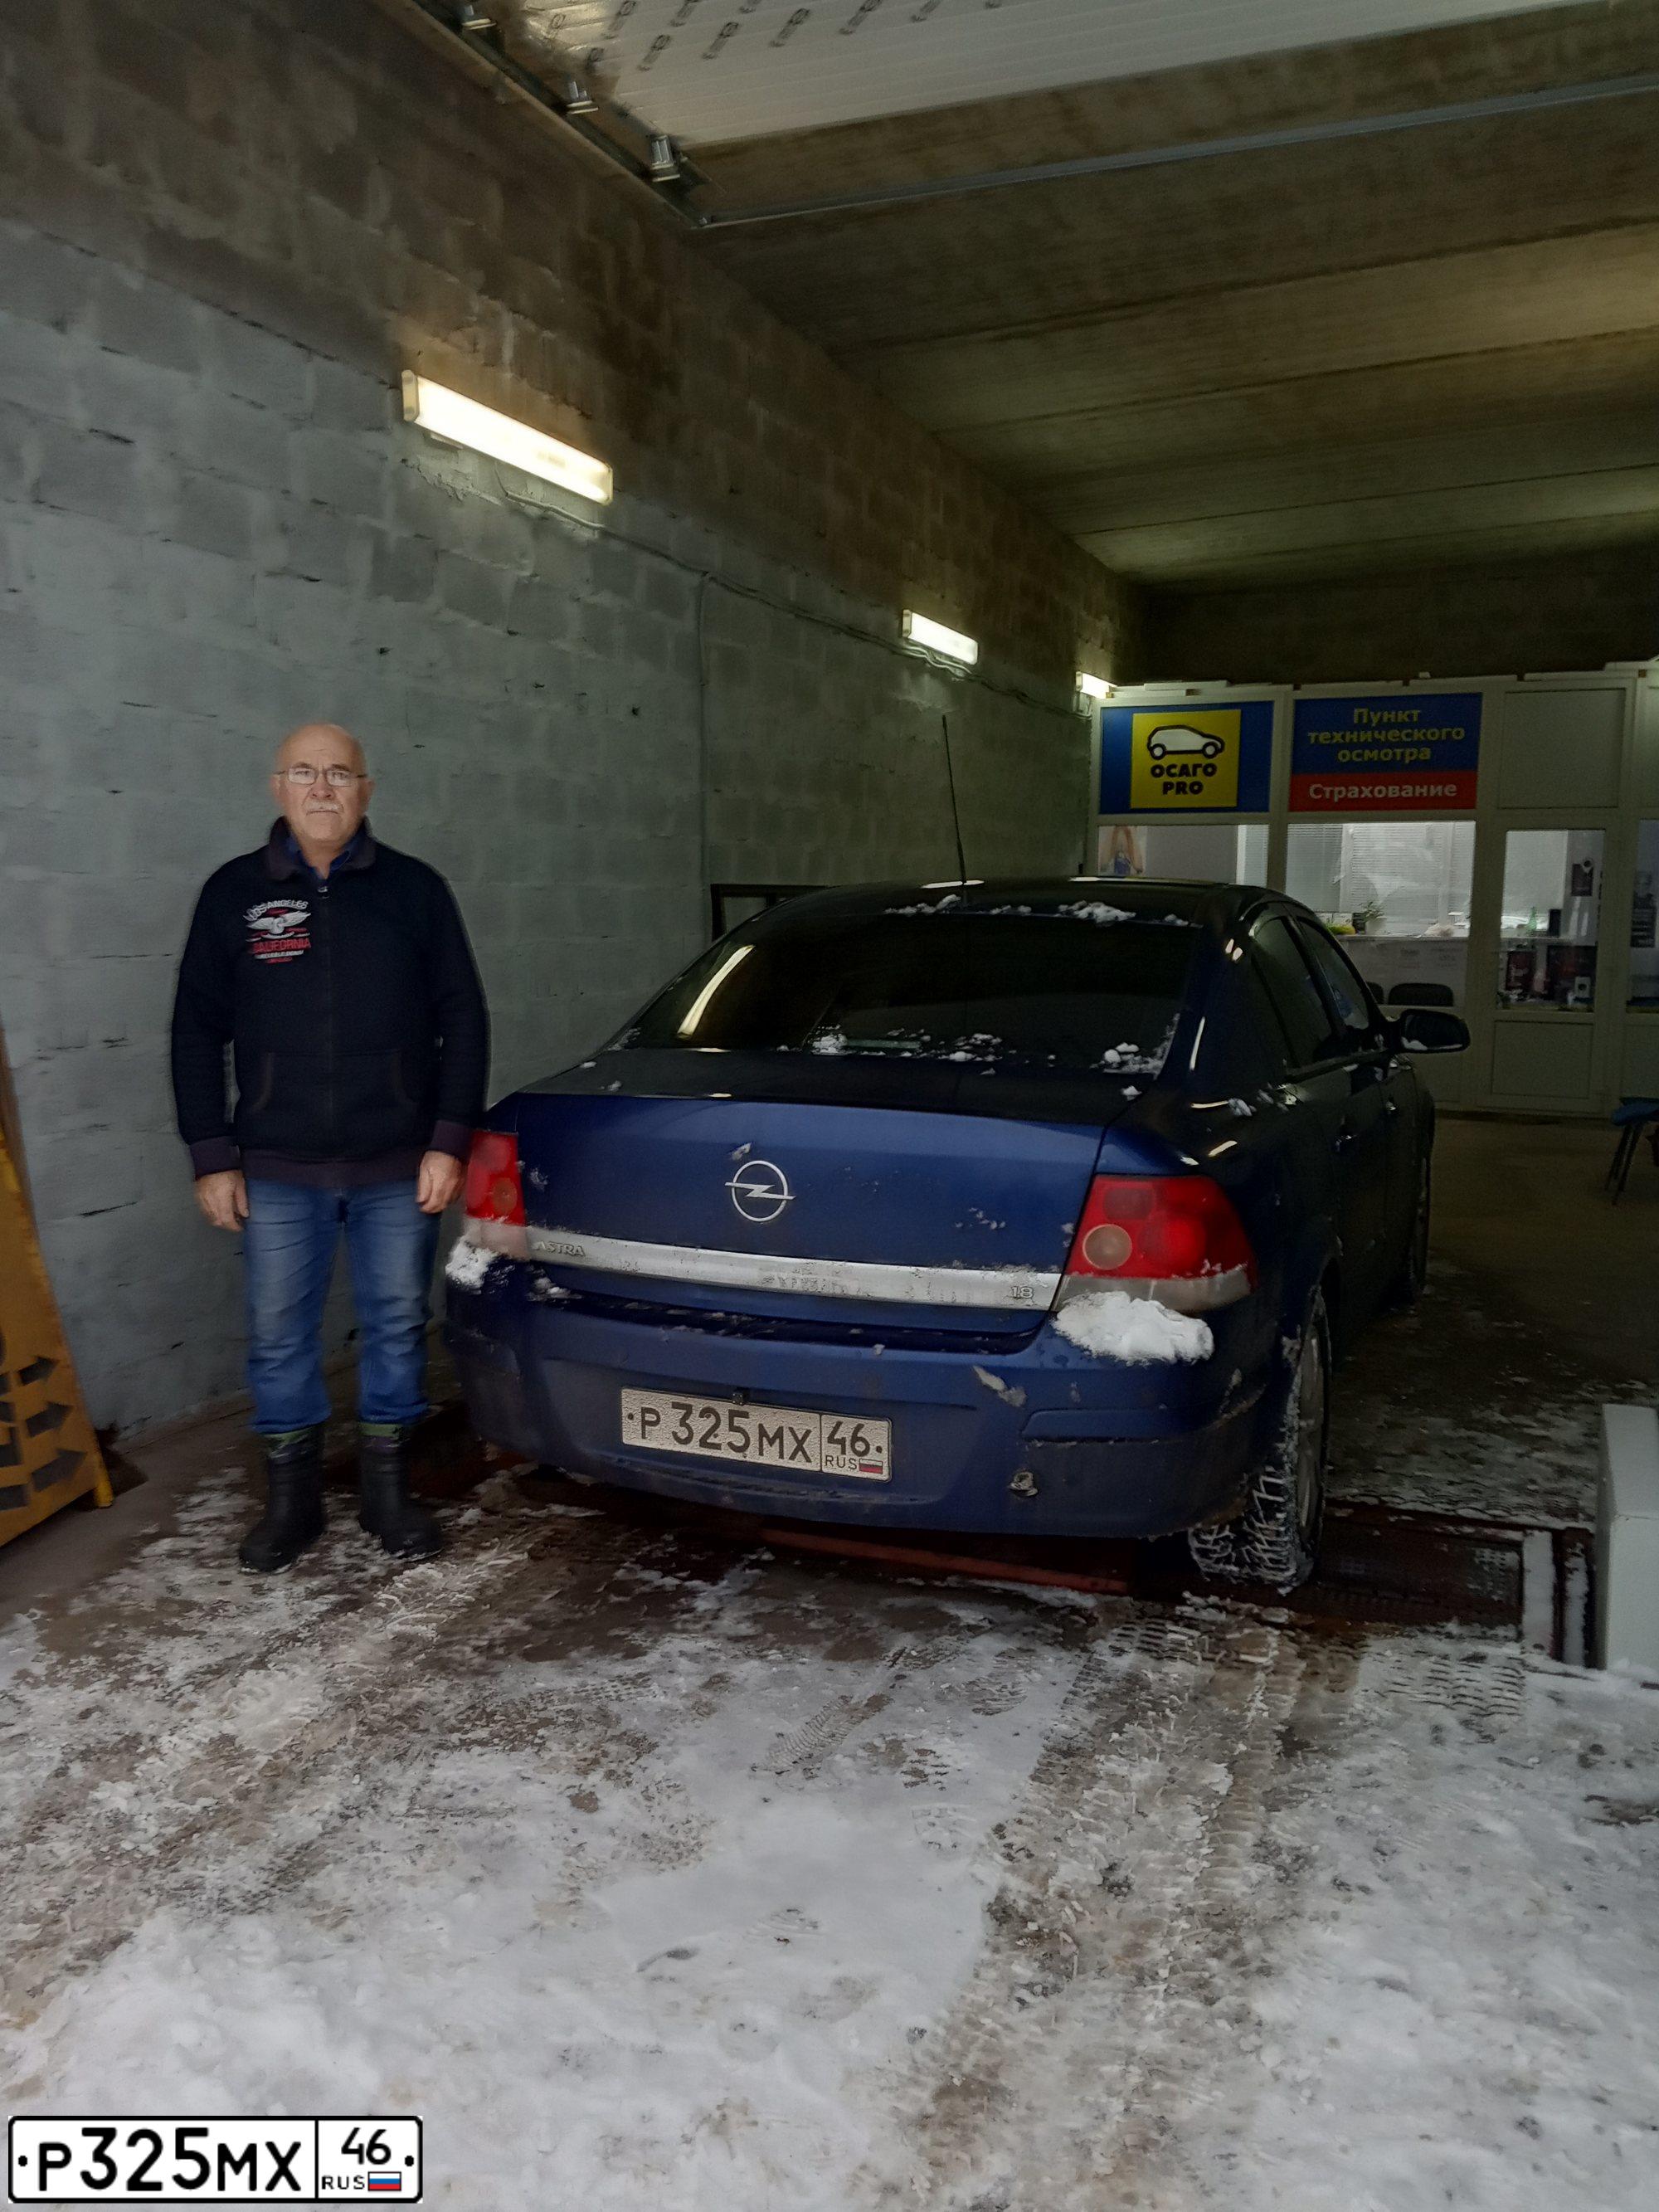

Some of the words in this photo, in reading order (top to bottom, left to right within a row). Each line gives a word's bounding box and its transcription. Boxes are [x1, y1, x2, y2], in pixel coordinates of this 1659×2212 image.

[1353, 708, 1421, 727] Пункт
[1307, 727, 1466, 744] технического
[1337, 748, 1432, 764] осмотра
[1151, 763, 1218, 778] ОСАГО
[1162, 781, 1204, 795] PRO
[1309, 783, 1457, 802] Страхование
[532, 1240, 586, 1257] ASTRA
[640, 1401, 812, 1463] Р325МХ
[826, 1420, 871, 1458] 46
[825, 1454, 858, 1470] RUS
